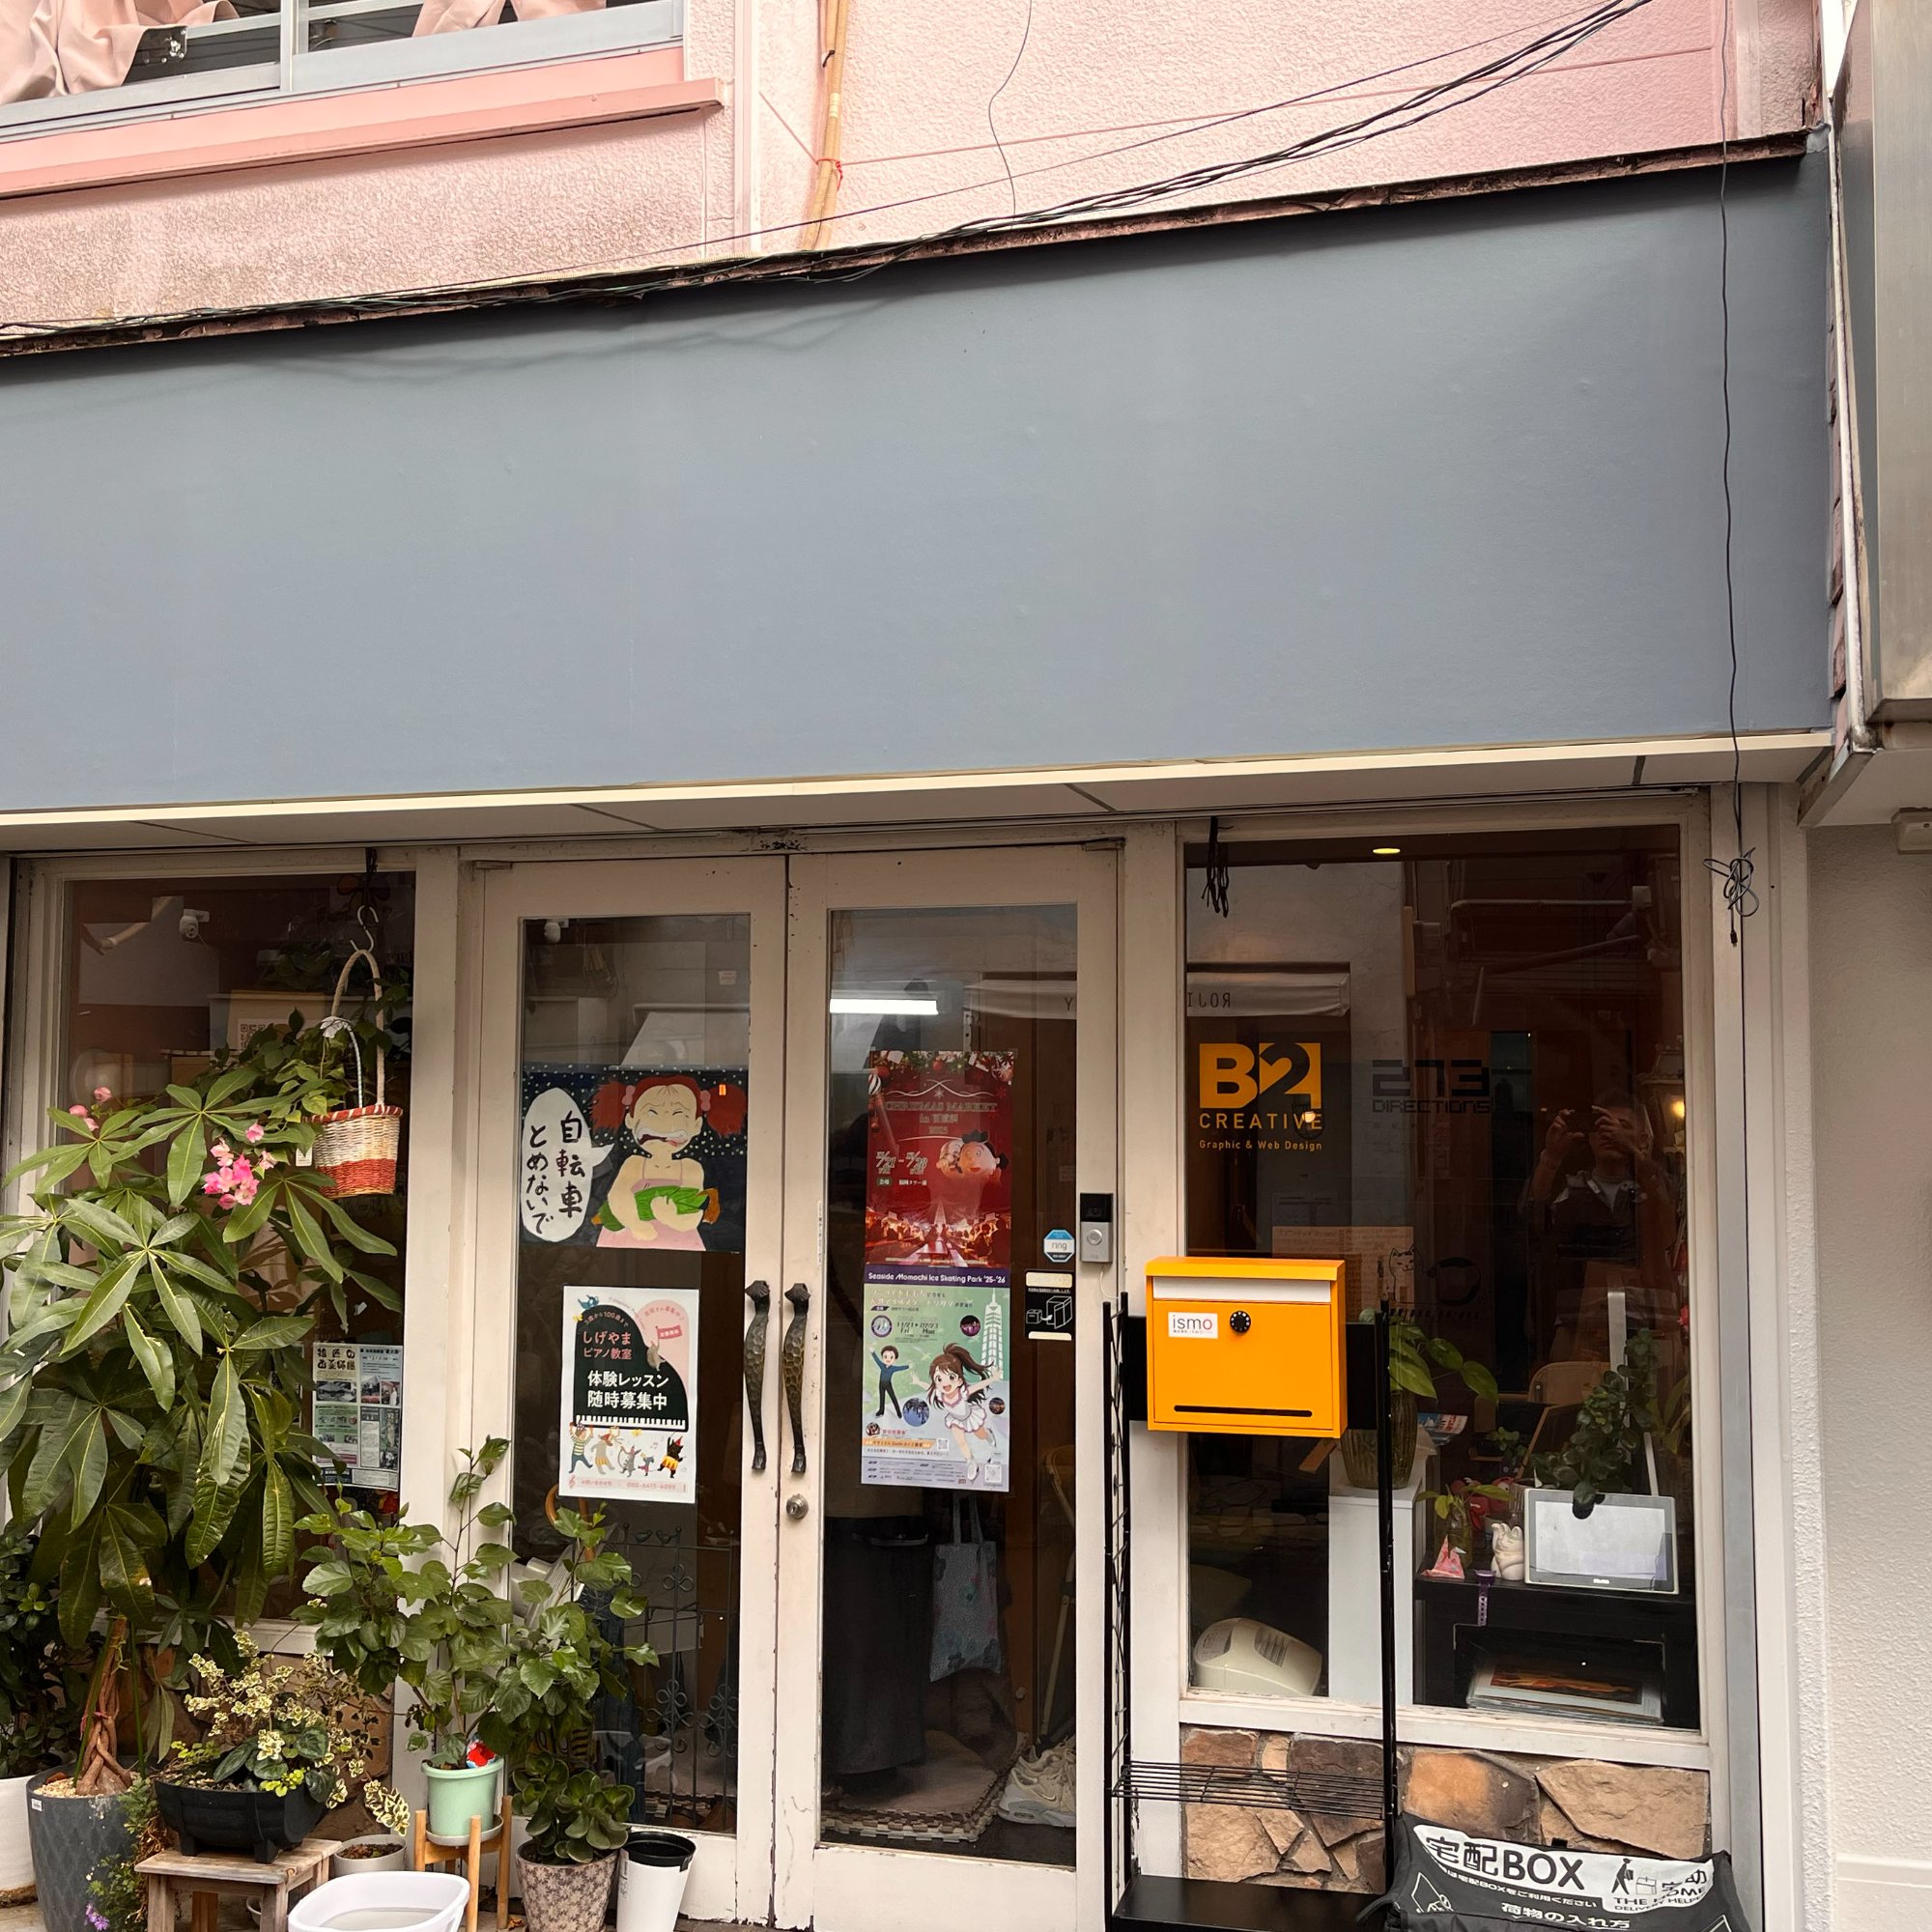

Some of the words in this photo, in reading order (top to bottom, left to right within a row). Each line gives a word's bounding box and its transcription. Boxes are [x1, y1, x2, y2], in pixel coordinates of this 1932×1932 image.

[1199, 1042, 1321, 1109] B2
[1372, 1059, 1490, 1096] 273
[1199, 1113, 1322, 1130] CREATIVE
[1199, 1139, 1241, 1151] Graphic
[1245, 1140, 1253, 1150] &
[1258, 1140, 1280, 1150] Web
[1285, 1140, 1322, 1152] Design
[555, 1111, 585, 1218] 自転車
[526, 1125, 554, 1235] とめないで
[1051, 1241, 1067, 1251] ring
[1173, 1314, 1212, 1330] ismo
[582, 1330, 632, 1345] しげやま
[583, 1348, 633, 1360] ピアノ教室
[587, 1370, 668, 1388] 体験レッスン
[587, 1390, 668, 1411] 随時募集中
[1426, 1836, 1585, 1890] 宅配BOX
[1613, 1896, 1648, 1906] THE
[1501, 1901, 1631, 1929] 荷物の入れ方
